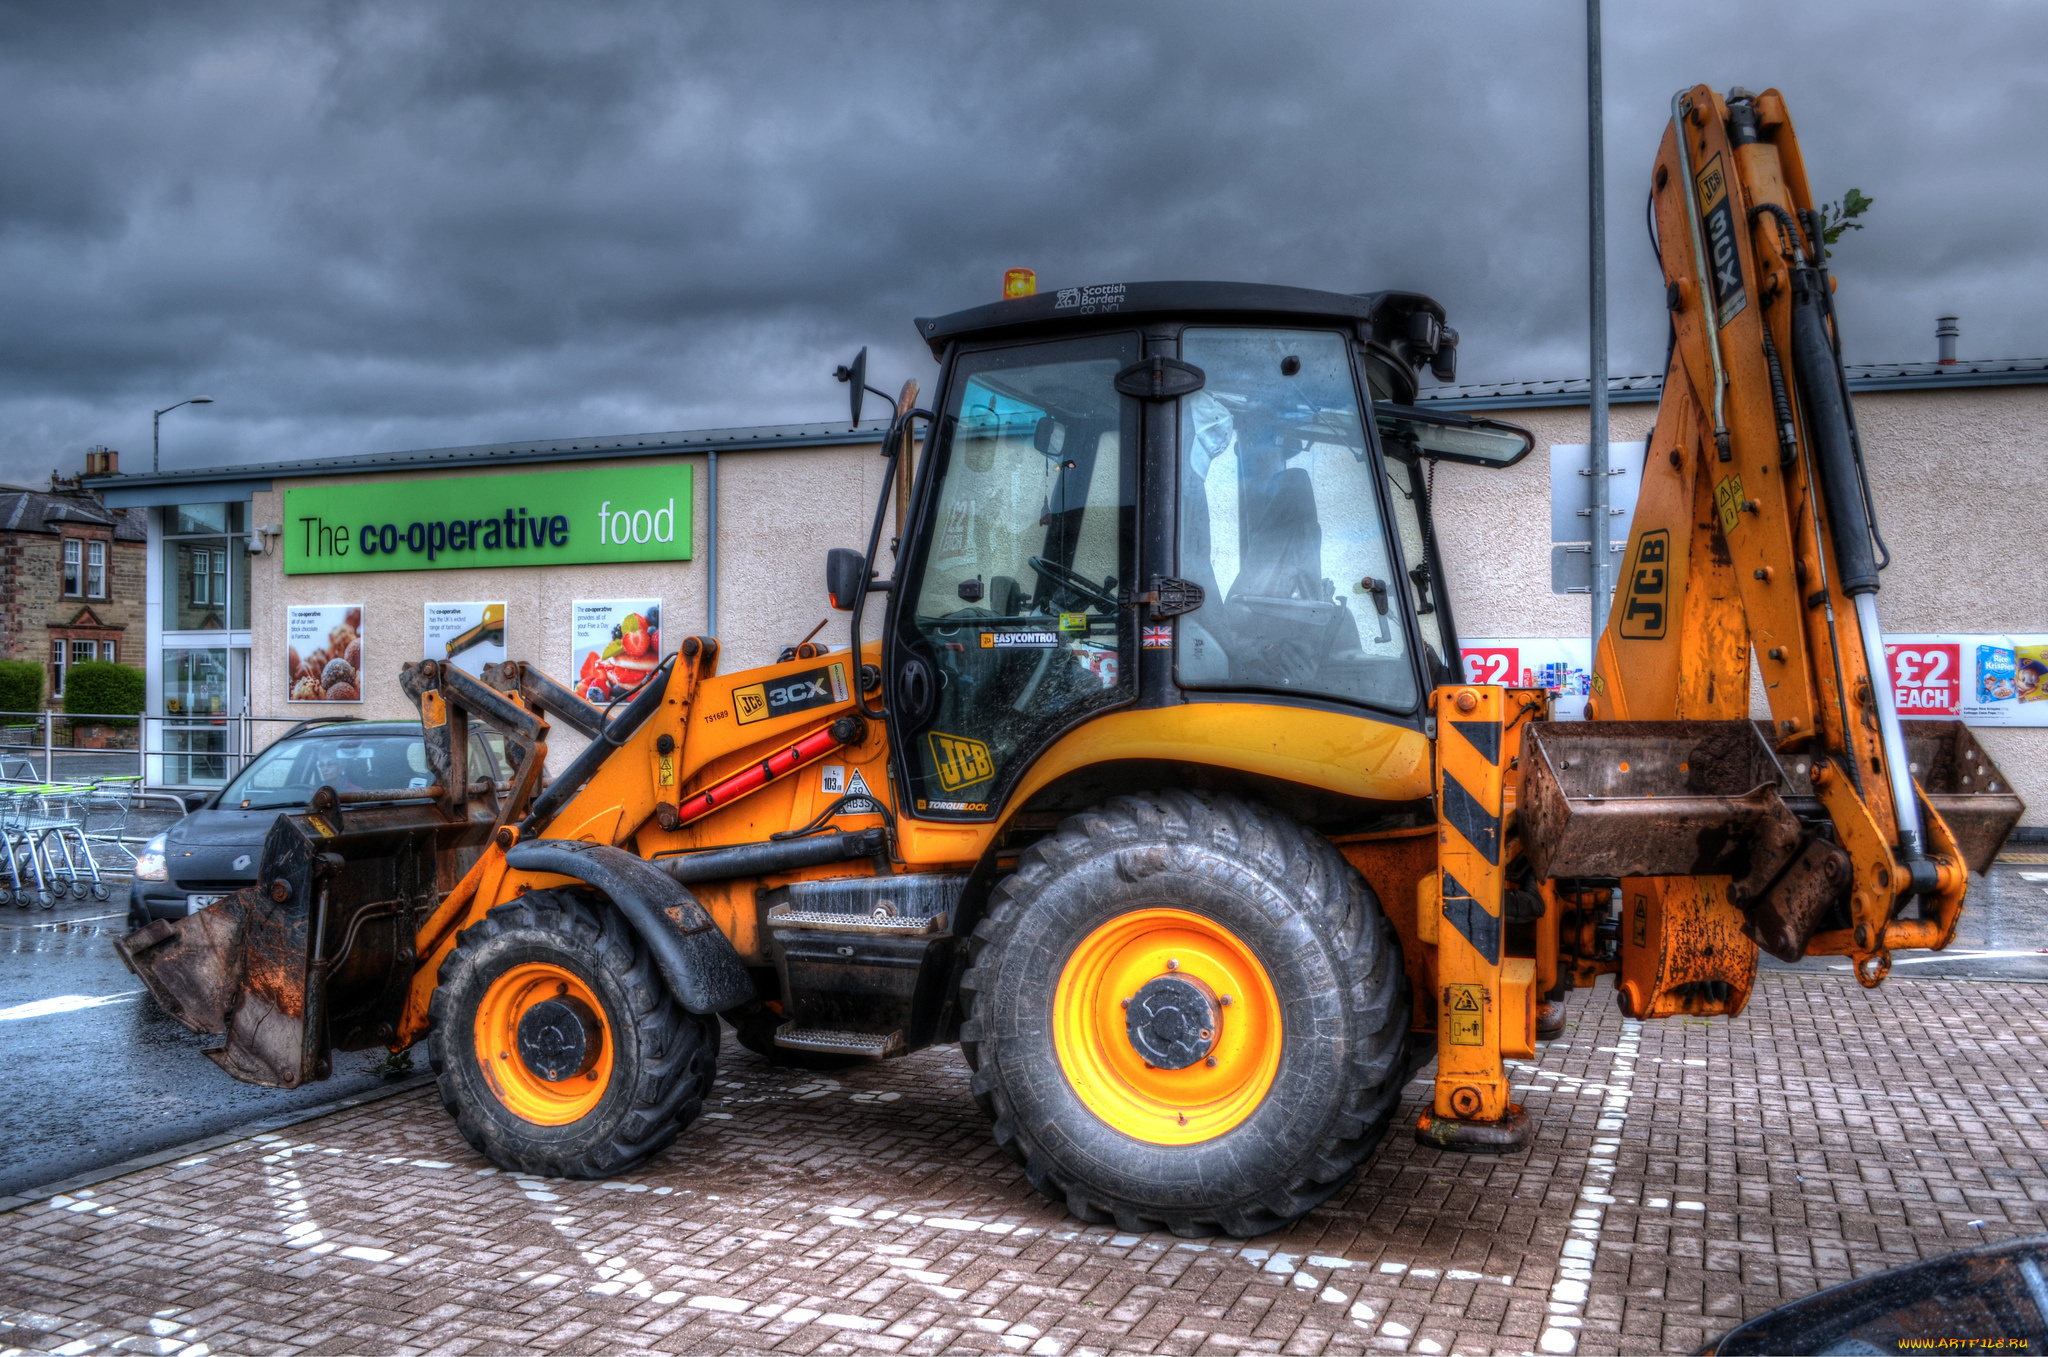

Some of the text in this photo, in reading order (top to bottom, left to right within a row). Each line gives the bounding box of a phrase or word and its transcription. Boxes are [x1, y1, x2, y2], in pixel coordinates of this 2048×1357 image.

[1703, 173, 1722, 200] JCB
[1709, 209, 1738, 297] 3CX
[1082, 283, 1126, 296] Scottish
[1081, 293, 1125, 306] Borders
[299, 498, 674, 560] The co-operative food
[1626, 538, 1665, 630] JCB
[993, 633, 1059, 646] EASYCONTROL
[1985, 661, 2015, 670] Krispies
[1993, 655, 2009, 663] Rice
[1463, 653, 1510, 687] £2
[1895, 650, 1949, 688] £2
[769, 677, 828, 707] 3CX
[1895, 689, 1949, 708] EACH
[741, 695, 763, 713] JCB
[704, 710, 729, 723] TS1689
[939, 738, 990, 785] JCB
[824, 777, 837, 790] 103
[928, 801, 989, 811] TORQUELOCK
